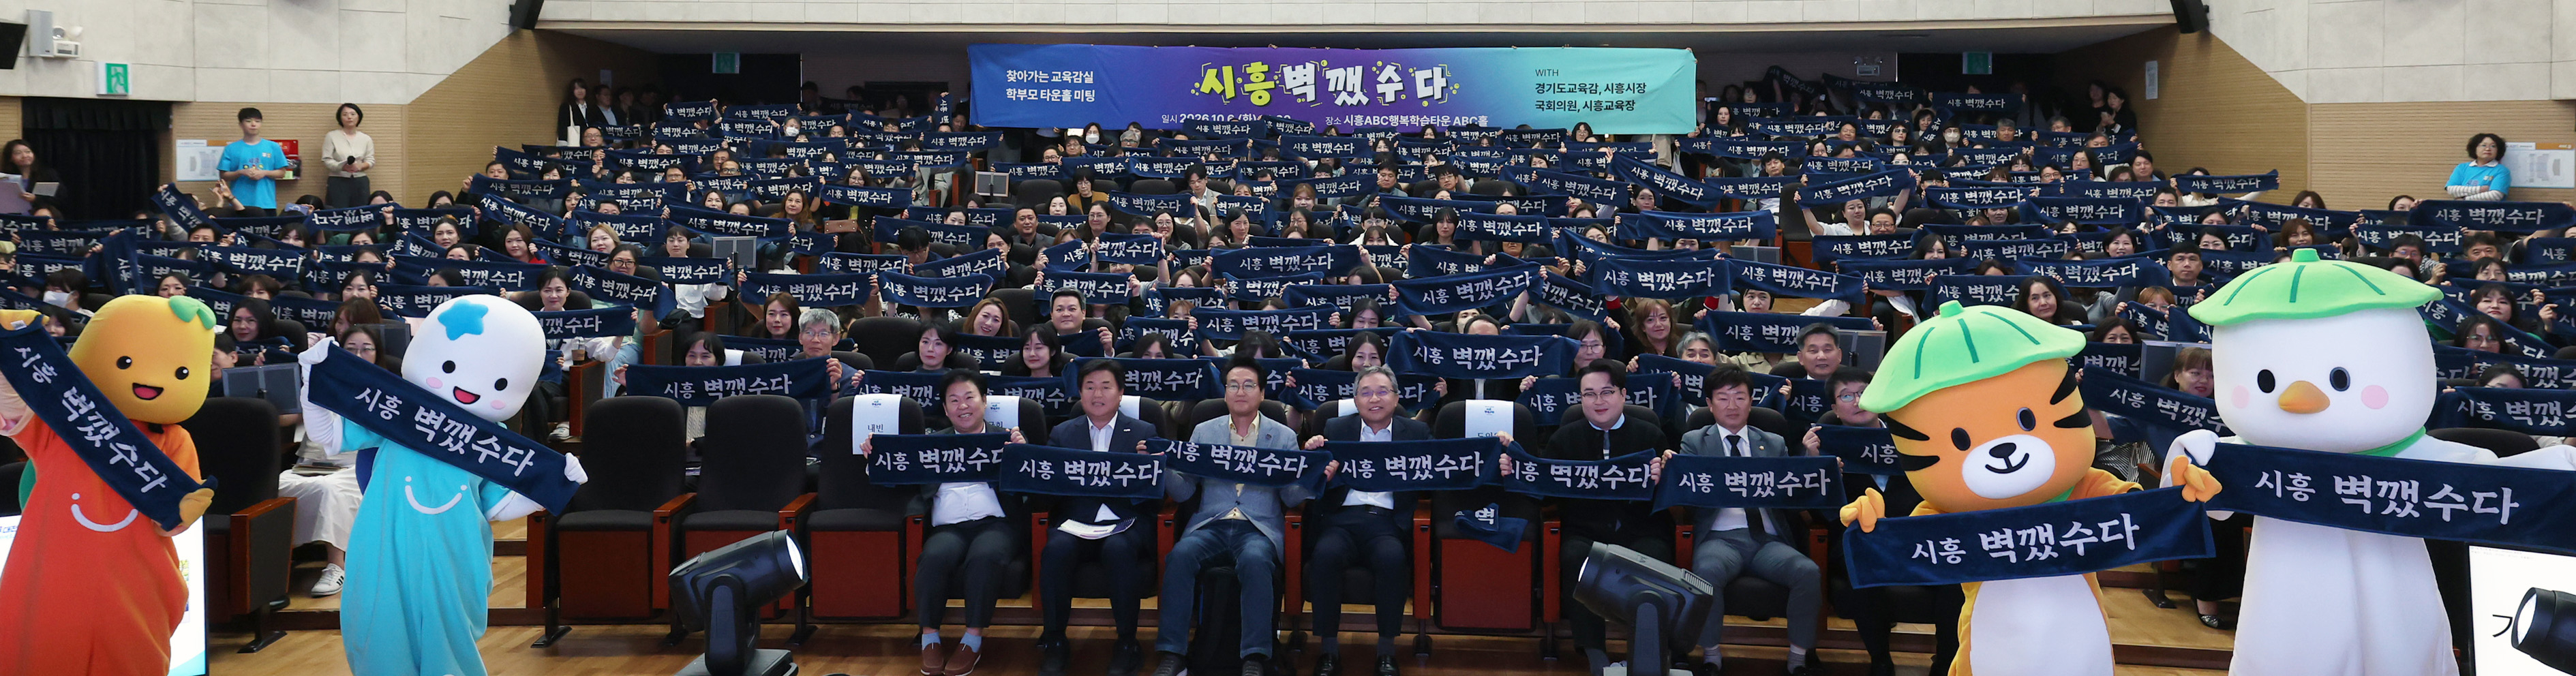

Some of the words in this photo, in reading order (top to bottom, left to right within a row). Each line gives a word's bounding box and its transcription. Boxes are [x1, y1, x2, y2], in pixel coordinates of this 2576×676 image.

[1006, 70, 1048, 84] 찾아가는
[1051, 70, 1093, 84] 교육감실
[1006, 89, 1038, 101] 학부모
[1040, 89, 1072, 102] 타운홀
[1074, 89, 1095, 102] 미팅
[1535, 82, 1601, 95] 경기도교육감,
[1605, 82, 1646, 95] 시흥시장
[678, 107, 712, 118] 벽깼수다
[1535, 100, 1580, 112] 국회의원,
[1583, 100, 1635, 112] 시흥교육장
[735, 122, 773, 134] 벽깼수다
[1162, 117, 1177, 125] 일시
[1276, 121, 1313, 134] 벽깼수다
[1325, 117, 1342, 127] 장소
[1213, 124, 1250, 135] 벽깼수다
[1767, 124, 1781, 132] 시흥
[1785, 123, 1825, 134] 벽깼수다
[1964, 129, 1977, 138] 시흥
[949, 136, 986, 147] 벽깼수다
[1293, 143, 1308, 152] 시흥
[1312, 142, 1354, 155] 벽깼수다
[1693, 141, 1706, 149] 시흥
[1727, 145, 1742, 154] 시흥
[514, 157, 529, 167] 시흥
[620, 158, 633, 167] 시흥
[638, 158, 680, 170] 벽깼수다
[913, 153, 954, 166] 벽깼수다
[1577, 158, 1592, 167] 시흥
[2051, 154, 2067, 162] 시흥
[864, 162, 907, 174] 벽깼수다
[1009, 168, 1023, 176] 시흥
[1135, 162, 1149, 172] 시흥
[1240, 168, 1254, 176] 시흥
[1807, 160, 1823, 170] 시흥
[1828, 159, 1873, 172] 벽깼수다
[1515, 173, 1530, 183] 시흥
[1631, 166, 1649, 180] 시흥
[1653, 174, 1703, 201] 벽깼수다
[2192, 180, 2208, 189] 시흥
[2213, 178, 2261, 191] 벽깼수다
[489, 182, 506, 191] 시흥
[511, 183, 554, 195] 벽깼수다
[1316, 181, 1361, 194] 벽깼수다
[1542, 178, 1560, 189] 시흥
[1565, 181, 1617, 200] 벽깼수다
[1738, 182, 1783, 195] 벽깼수다
[1815, 188, 1832, 200] 시흥
[1837, 175, 1892, 197] 벽깼수다
[2085, 189, 2102, 198] 시흥
[827, 189, 843, 199] 시흥
[847, 189, 892, 204] 벽깼수다
[1112, 196, 1128, 206] 시흥
[1939, 192, 1958, 203] 시흥
[1965, 186, 2023, 204] 벽깼수다
[481, 197, 498, 211] 시흥
[503, 206, 550, 231] 벽깼수다
[1399, 206, 1416, 215] 시흥
[2040, 206, 2060, 218] 시흥
[2066, 204, 2124, 220] 벽깼수다
[2436, 209, 2461, 221] 시흥
[2469, 208, 2545, 226] 벽깼수다
[687, 217, 707, 229] 시흥
[714, 219, 769, 237] 벽깼수다
[1457, 219, 1477, 231] 시흥
[1483, 220, 1543, 236] 벽깼수다
[1664, 219, 1686, 231] 시흥
[1692, 218, 1753, 234] 벽깼수다
[2358, 230, 2381, 244] 시흥
[19, 239, 44, 251] 시흥
[1832, 242, 1853, 256] 시흥
[1972, 248, 1995, 261] 시흥
[2001, 241, 2071, 262] 벽깼수다
[1064, 249, 1085, 263] 시흥
[2543, 248, 2566, 260] 시흥
[197, 250, 222, 262] 시흥
[230, 252, 305, 273] 벽깼수다
[820, 256, 842, 271] 시흥
[849, 256, 908, 275] 벽깼수다
[1240, 258, 1262, 271] 시흥
[1269, 253, 1333, 271] 벽깼수다
[1436, 260, 1457, 274] 시흥
[2209, 259, 2234, 273] 시흥
[305, 271, 329, 283] 시흥
[662, 264, 725, 280] 벽깼수다
[1604, 270, 1631, 287] 시흥
[1637, 267, 1715, 291] 벽깼수다
[1864, 271, 1886, 283] 시흥
[2065, 263, 2139, 283] 벽깼수다
[1742, 266, 1766, 281] 시흥
[1772, 268, 1838, 293] 벽깼수다
[573, 273, 596, 288] 시흥
[603, 280, 657, 303] 벽깼수다
[789, 283, 858, 303] 벽깼수다
[883, 281, 908, 297] 시흥
[913, 283, 982, 303] 벽깼수다
[1423, 289, 1449, 304] 시흥
[1456, 271, 1532, 303] 벽깼수다
[1938, 285, 1961, 298] 시흥
[380, 296, 406, 309] 시흥
[1207, 318, 1235, 333] 시흥
[1243, 313, 1320, 334] 벽깼수다
[1725, 325, 1754, 341] 시흥
[1414, 345, 1444, 365] 시흥
[1453, 345, 1543, 371] 벽깼수다
[665, 382, 695, 399] 시흥
[704, 373, 792, 399] 벽깼수다
[1125, 369, 1202, 392] 벽깼수다
[1299, 384, 1329, 402] 시흥
[1530, 393, 1558, 412] 시흥
[1791, 395, 1823, 413] 시흥
[2110, 388, 2145, 408] 시흥
[2157, 397, 2227, 433] 벽깼수
[2458, 399, 2496, 421] 시흥
[14, 347, 57, 383] 시흥
[62, 386, 168, 493] 벽깼수다
[354, 388, 402, 420] 시흥
[414, 405, 534, 476] 벽깼수다
[868, 425, 883, 433] 내빈
[1166, 441, 1200, 461] 시흥
[1211, 444, 1307, 478] 벽깼수다
[1861, 444, 1898, 464] 시흥
[876, 452, 909, 472] 시흥
[1342, 459, 1376, 478] 시흥
[1385, 451, 1483, 480] 벽깼수다
[1020, 459, 1055, 480] 시흥
[1065, 461, 1162, 487] 벽깼수다
[1550, 463, 1651, 490] 벽깼수다
[1679, 472, 1714, 493] 시흥
[1725, 469, 1831, 498] 벽깼수다
[2255, 470, 2316, 502] 시흥
[2333, 474, 2519, 525] 벽깼수다
[1912, 538, 1967, 565] 시흥
[1978, 512, 2140, 564] 벽깼수다
